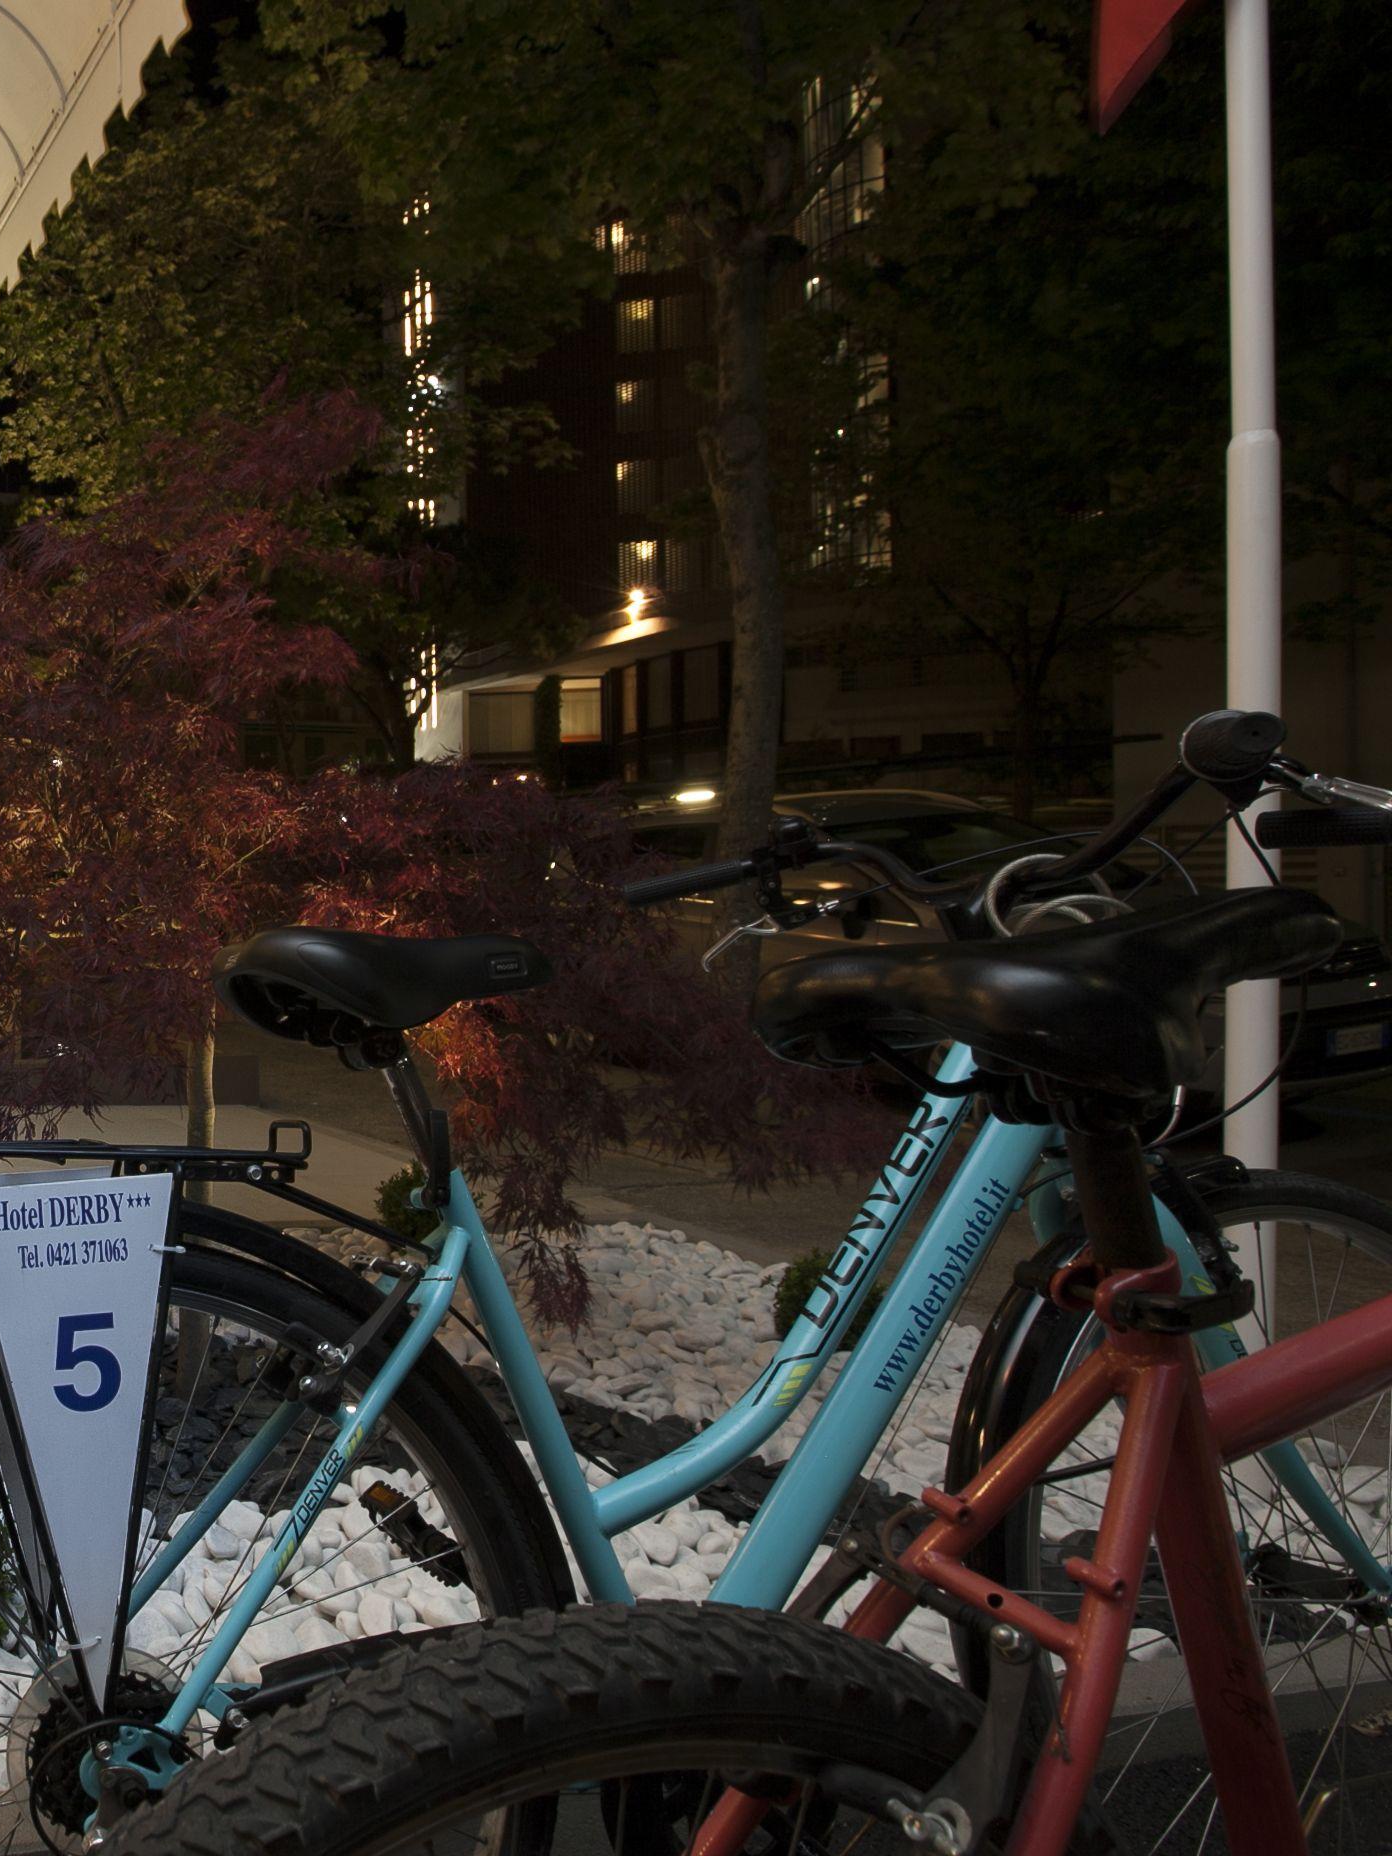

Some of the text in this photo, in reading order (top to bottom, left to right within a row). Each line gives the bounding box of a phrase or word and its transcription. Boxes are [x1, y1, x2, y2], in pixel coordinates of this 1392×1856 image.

[17, 1238, 129, 1269] Tel. 0421 371063
[49, 1192, 124, 1228] DERBY
[800, 1099, 950, 1330] DENVER
[872, 1177, 1012, 1393] www.derbyhotel.it
[53, 1311, 122, 1413] 5
[295, 1448, 345, 1524] DENVER
